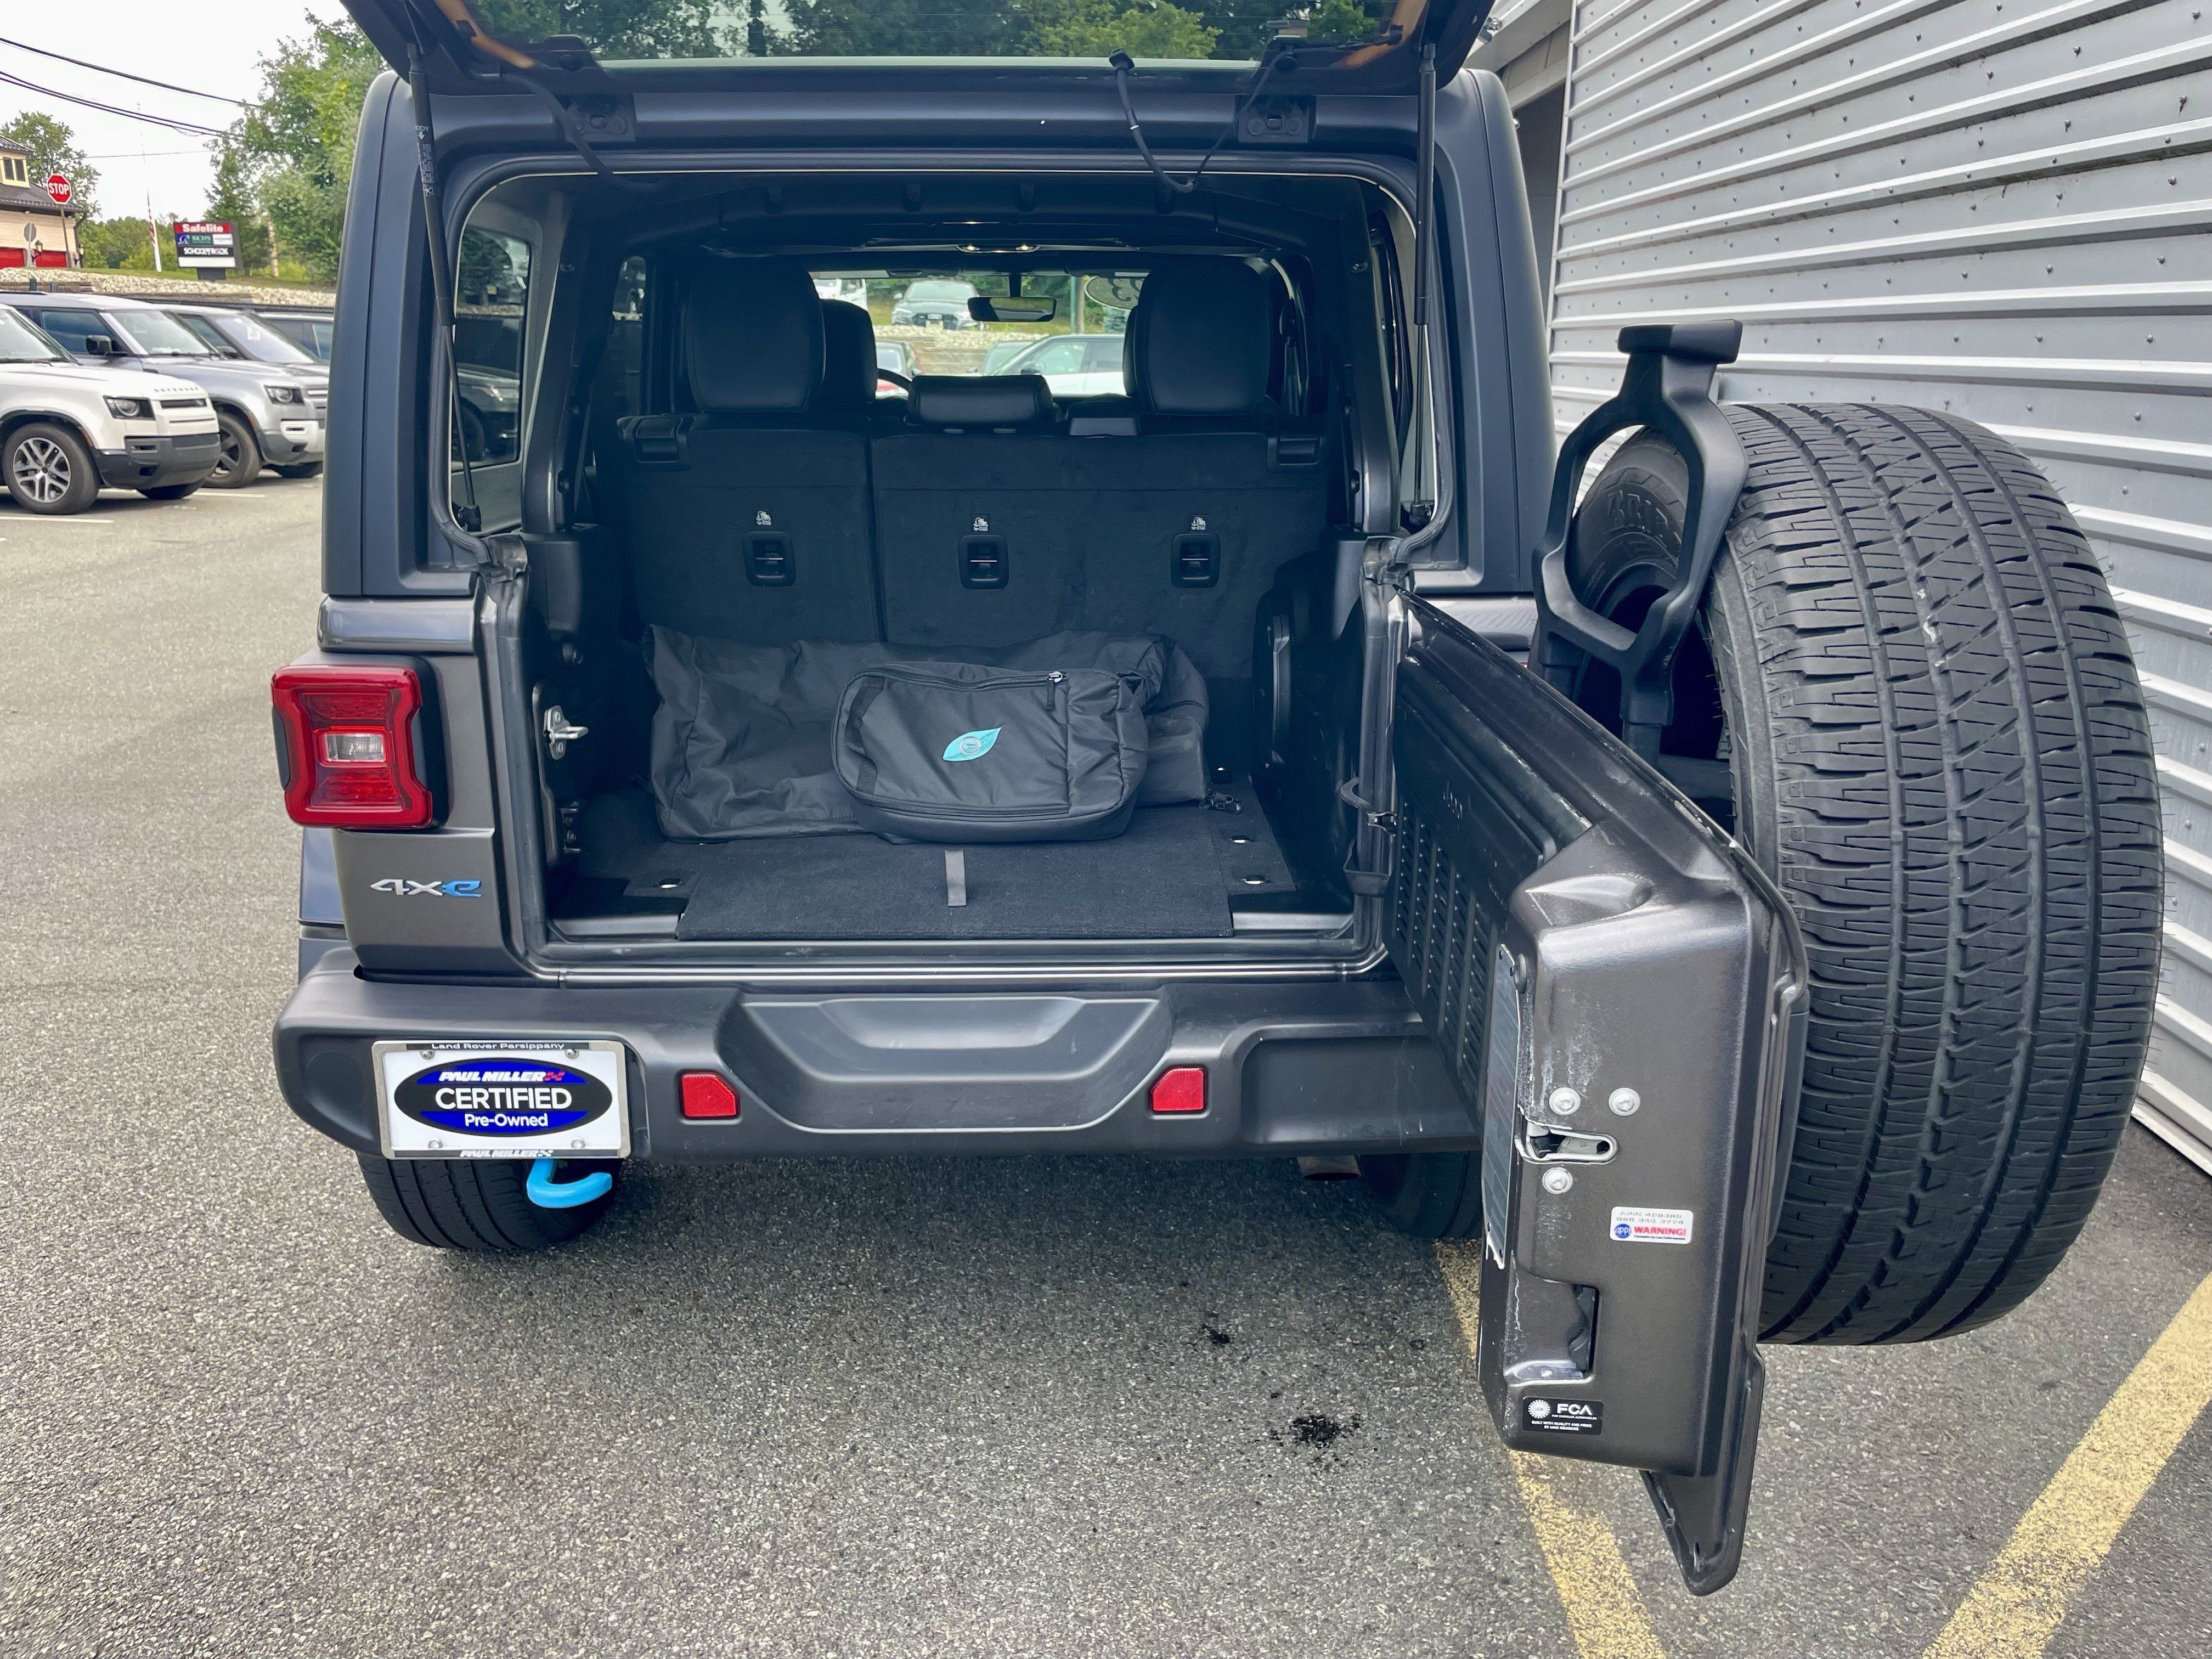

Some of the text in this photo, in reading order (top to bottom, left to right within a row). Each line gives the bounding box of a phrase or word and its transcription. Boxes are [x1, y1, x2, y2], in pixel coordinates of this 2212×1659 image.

[48, 182, 69, 195] STOP
[182, 224, 224, 232] Safelite
[438, 1071, 547, 1082] PAUL MILLER
[435, 1087, 572, 1109] CERTIFIED
[464, 1113, 549, 1127] Pre-Owned
[1634, 1225, 1686, 1236] WARNING!
[1557, 1403, 1593, 1416] FCA
